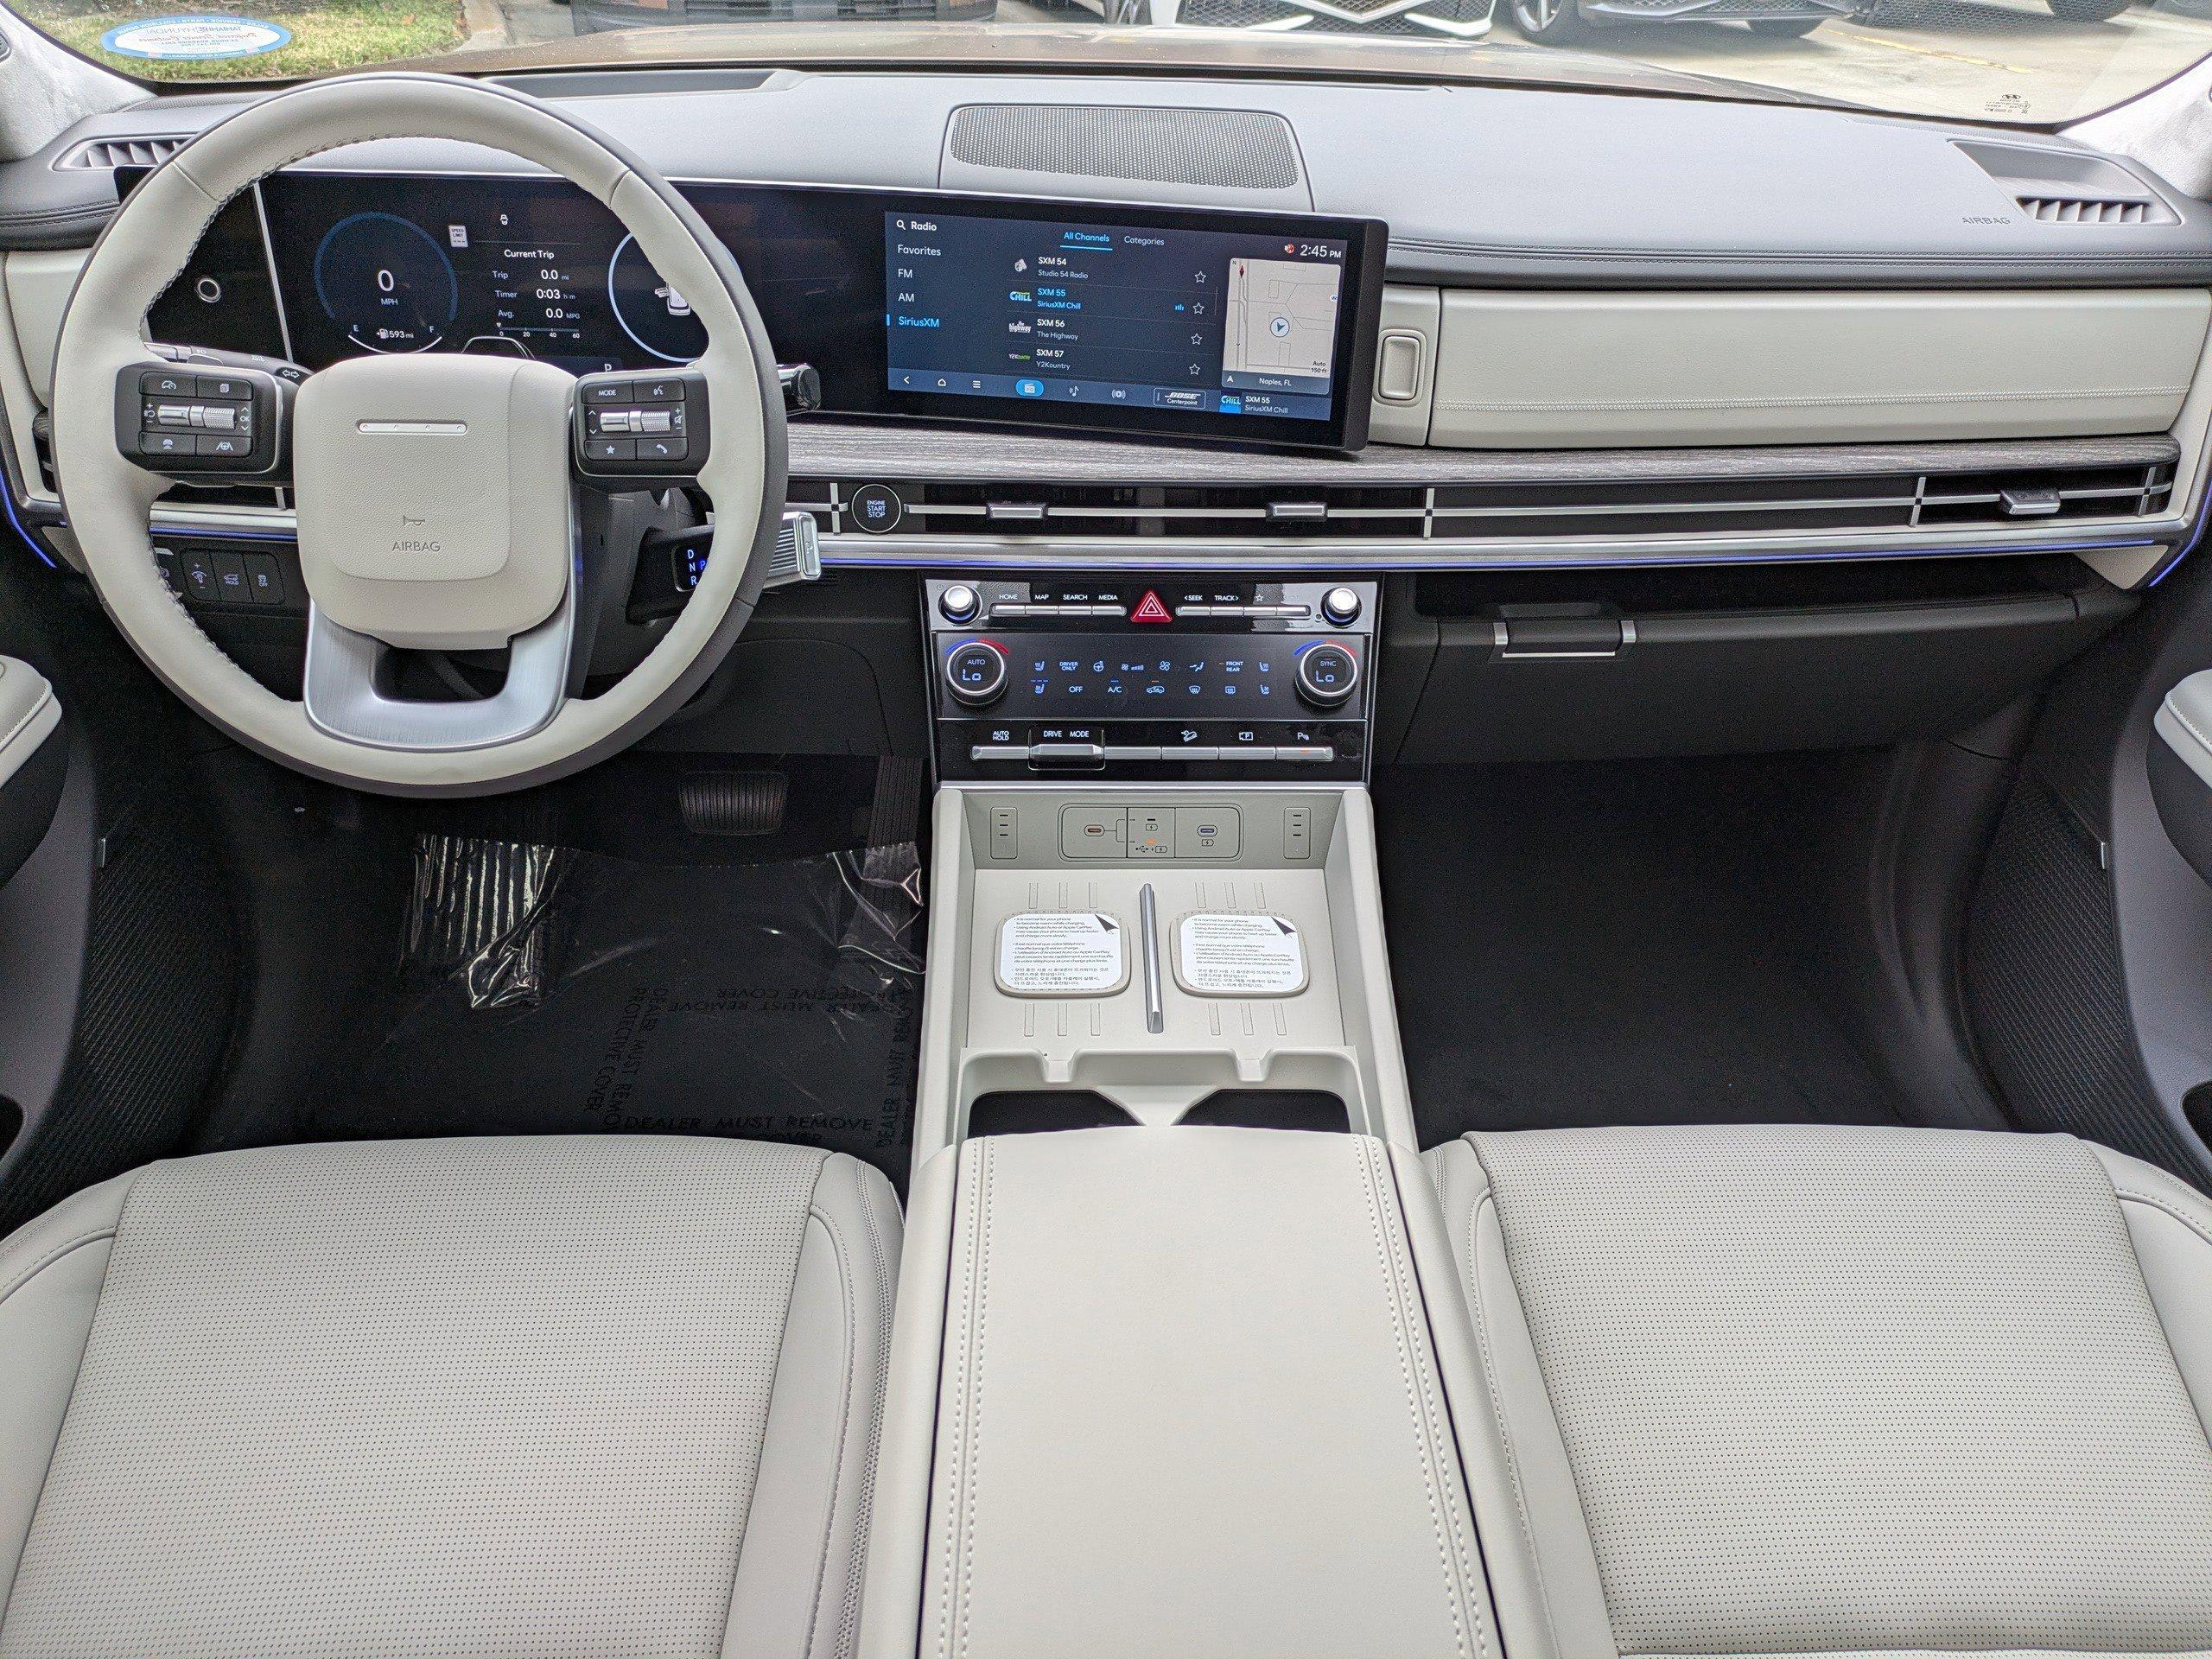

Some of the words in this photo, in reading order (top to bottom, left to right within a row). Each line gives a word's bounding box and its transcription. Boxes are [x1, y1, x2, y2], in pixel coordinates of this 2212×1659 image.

[1961, 216, 2011, 225] AIRBAG
[911, 221, 937, 232] Radio
[1064, 232, 1073, 240] All
[1075, 232, 1109, 242] Channels
[1124, 235, 1165, 247] Categories
[504, 249, 536, 258] Current
[537, 250, 555, 260] Trip
[897, 245, 941, 256] Favorites
[1300, 245, 1327, 257] 2:45
[1038, 257, 1055, 265] SXM
[493, 270, 508, 280] Trip
[541, 270, 558, 280] 0.0
[898, 269, 912, 279] FM
[378, 270, 394, 291] 0
[495, 289, 518, 298] Timer
[536, 289, 561, 300] 0:03
[898, 292, 914, 302] AM
[1038, 288, 1054, 296] SXM
[1037, 301, 1065, 309] SiriusXM
[498, 309, 514, 319] Avg.
[545, 308, 563, 319] 0.0
[899, 316, 939, 327] SiriusXM
[1037, 319, 1054, 327] SXM
[1050, 332, 1079, 341] Highway
[605, 364, 613, 372] P
[1036, 361, 1071, 370] Y2Kountry
[1259, 378, 1282, 387] Naples,
[1166, 397, 1198, 406] Centerpoint
[1244, 404, 1273, 413] SiriusXM
[392, 541, 441, 553] AIRBAG
[687, 550, 695, 560] D
[689, 563, 696, 572] N
[690, 576, 697, 586] R
[623, 1039, 647, 1076] MUST
[715, 1116, 776, 1130] MUST
[785, 1116, 874, 1132] REMOVE
